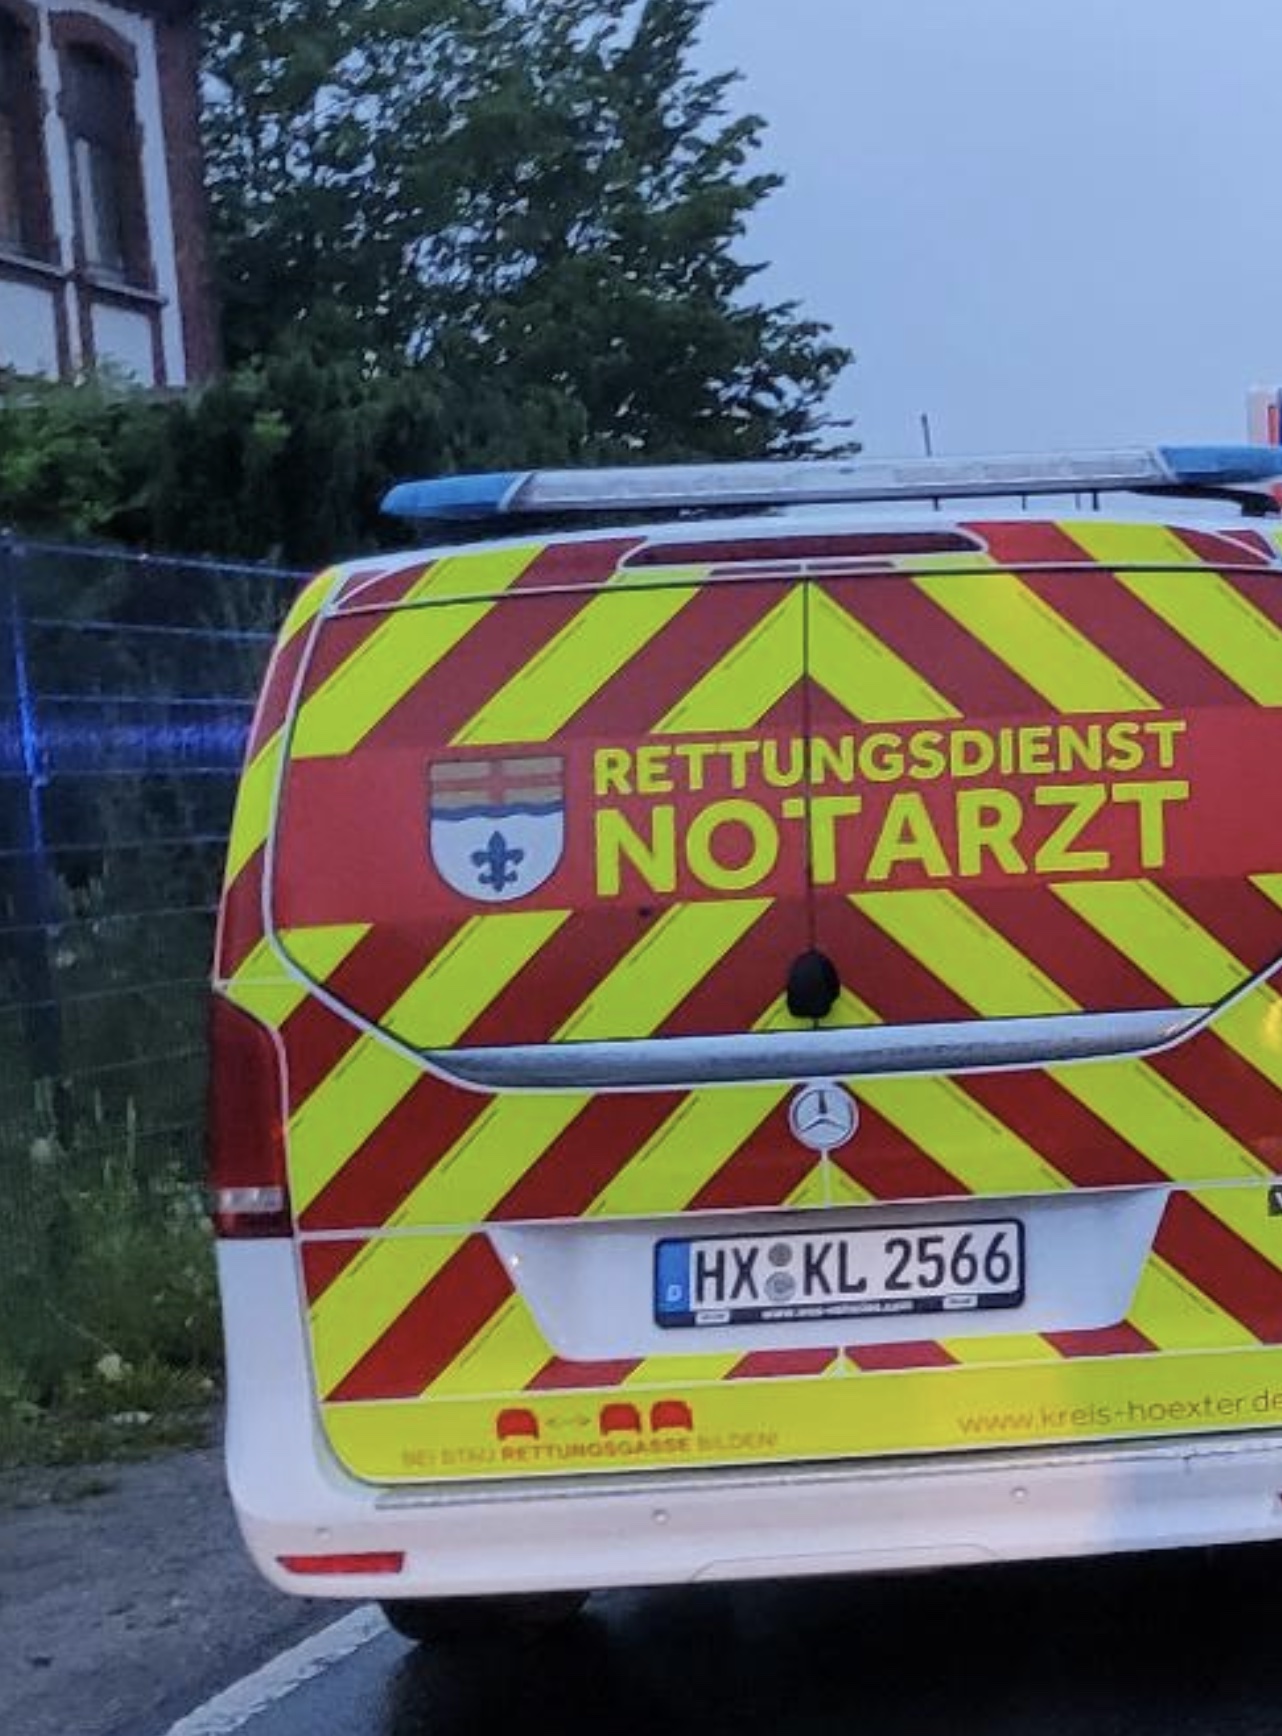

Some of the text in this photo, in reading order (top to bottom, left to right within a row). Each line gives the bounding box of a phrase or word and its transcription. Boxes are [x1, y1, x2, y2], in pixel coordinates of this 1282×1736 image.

[592, 721, 1187, 796] RETTUNGSDIENST
[594, 781, 1190, 897] NOTARZT
[697, 1246, 760, 1303] HX
[803, 1240, 868, 1297] KL
[884, 1231, 1012, 1291] 2566
[501, 1435, 692, 1462] RETTUNGSGASSE
